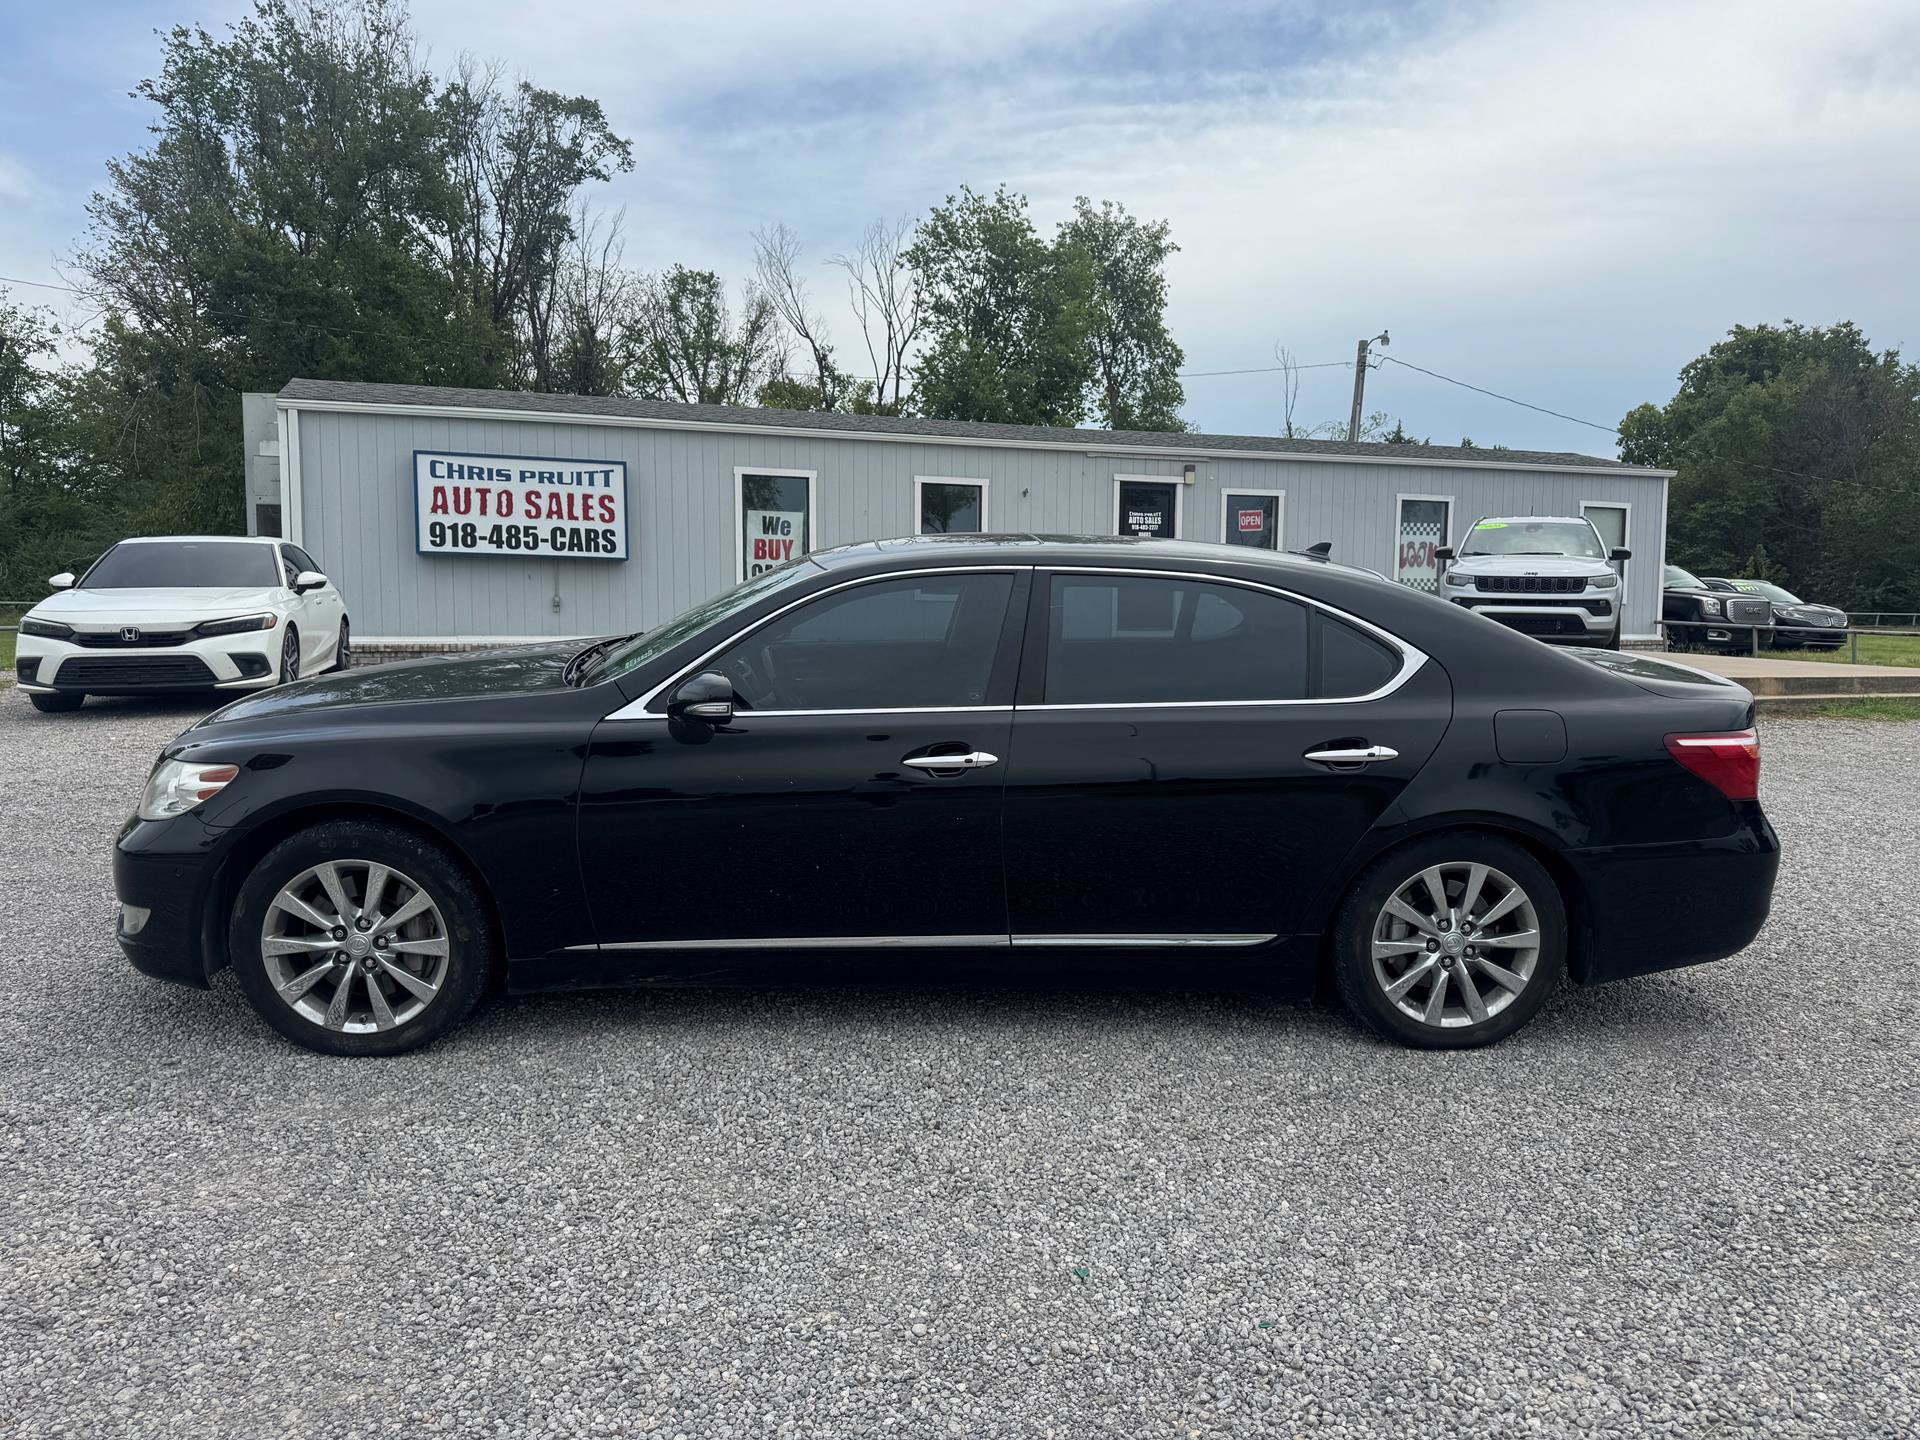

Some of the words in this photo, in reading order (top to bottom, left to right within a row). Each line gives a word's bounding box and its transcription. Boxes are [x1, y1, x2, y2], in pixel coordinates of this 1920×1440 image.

[429, 459, 512, 482] CHRIS
[519, 469, 615, 488] PRUITT
[430, 485, 514, 518] AUTO
[524, 490, 616, 524] SALES
[762, 515, 791, 536] We
[1129, 516, 1144, 524] AUTO
[1144, 517, 1162, 525] SALES
[1240, 515, 1261, 526] OPEN
[429, 521, 617, 554] 918-485-CARS
[754, 538, 794, 561] BUY
[1400, 541, 1438, 569] LOOK
